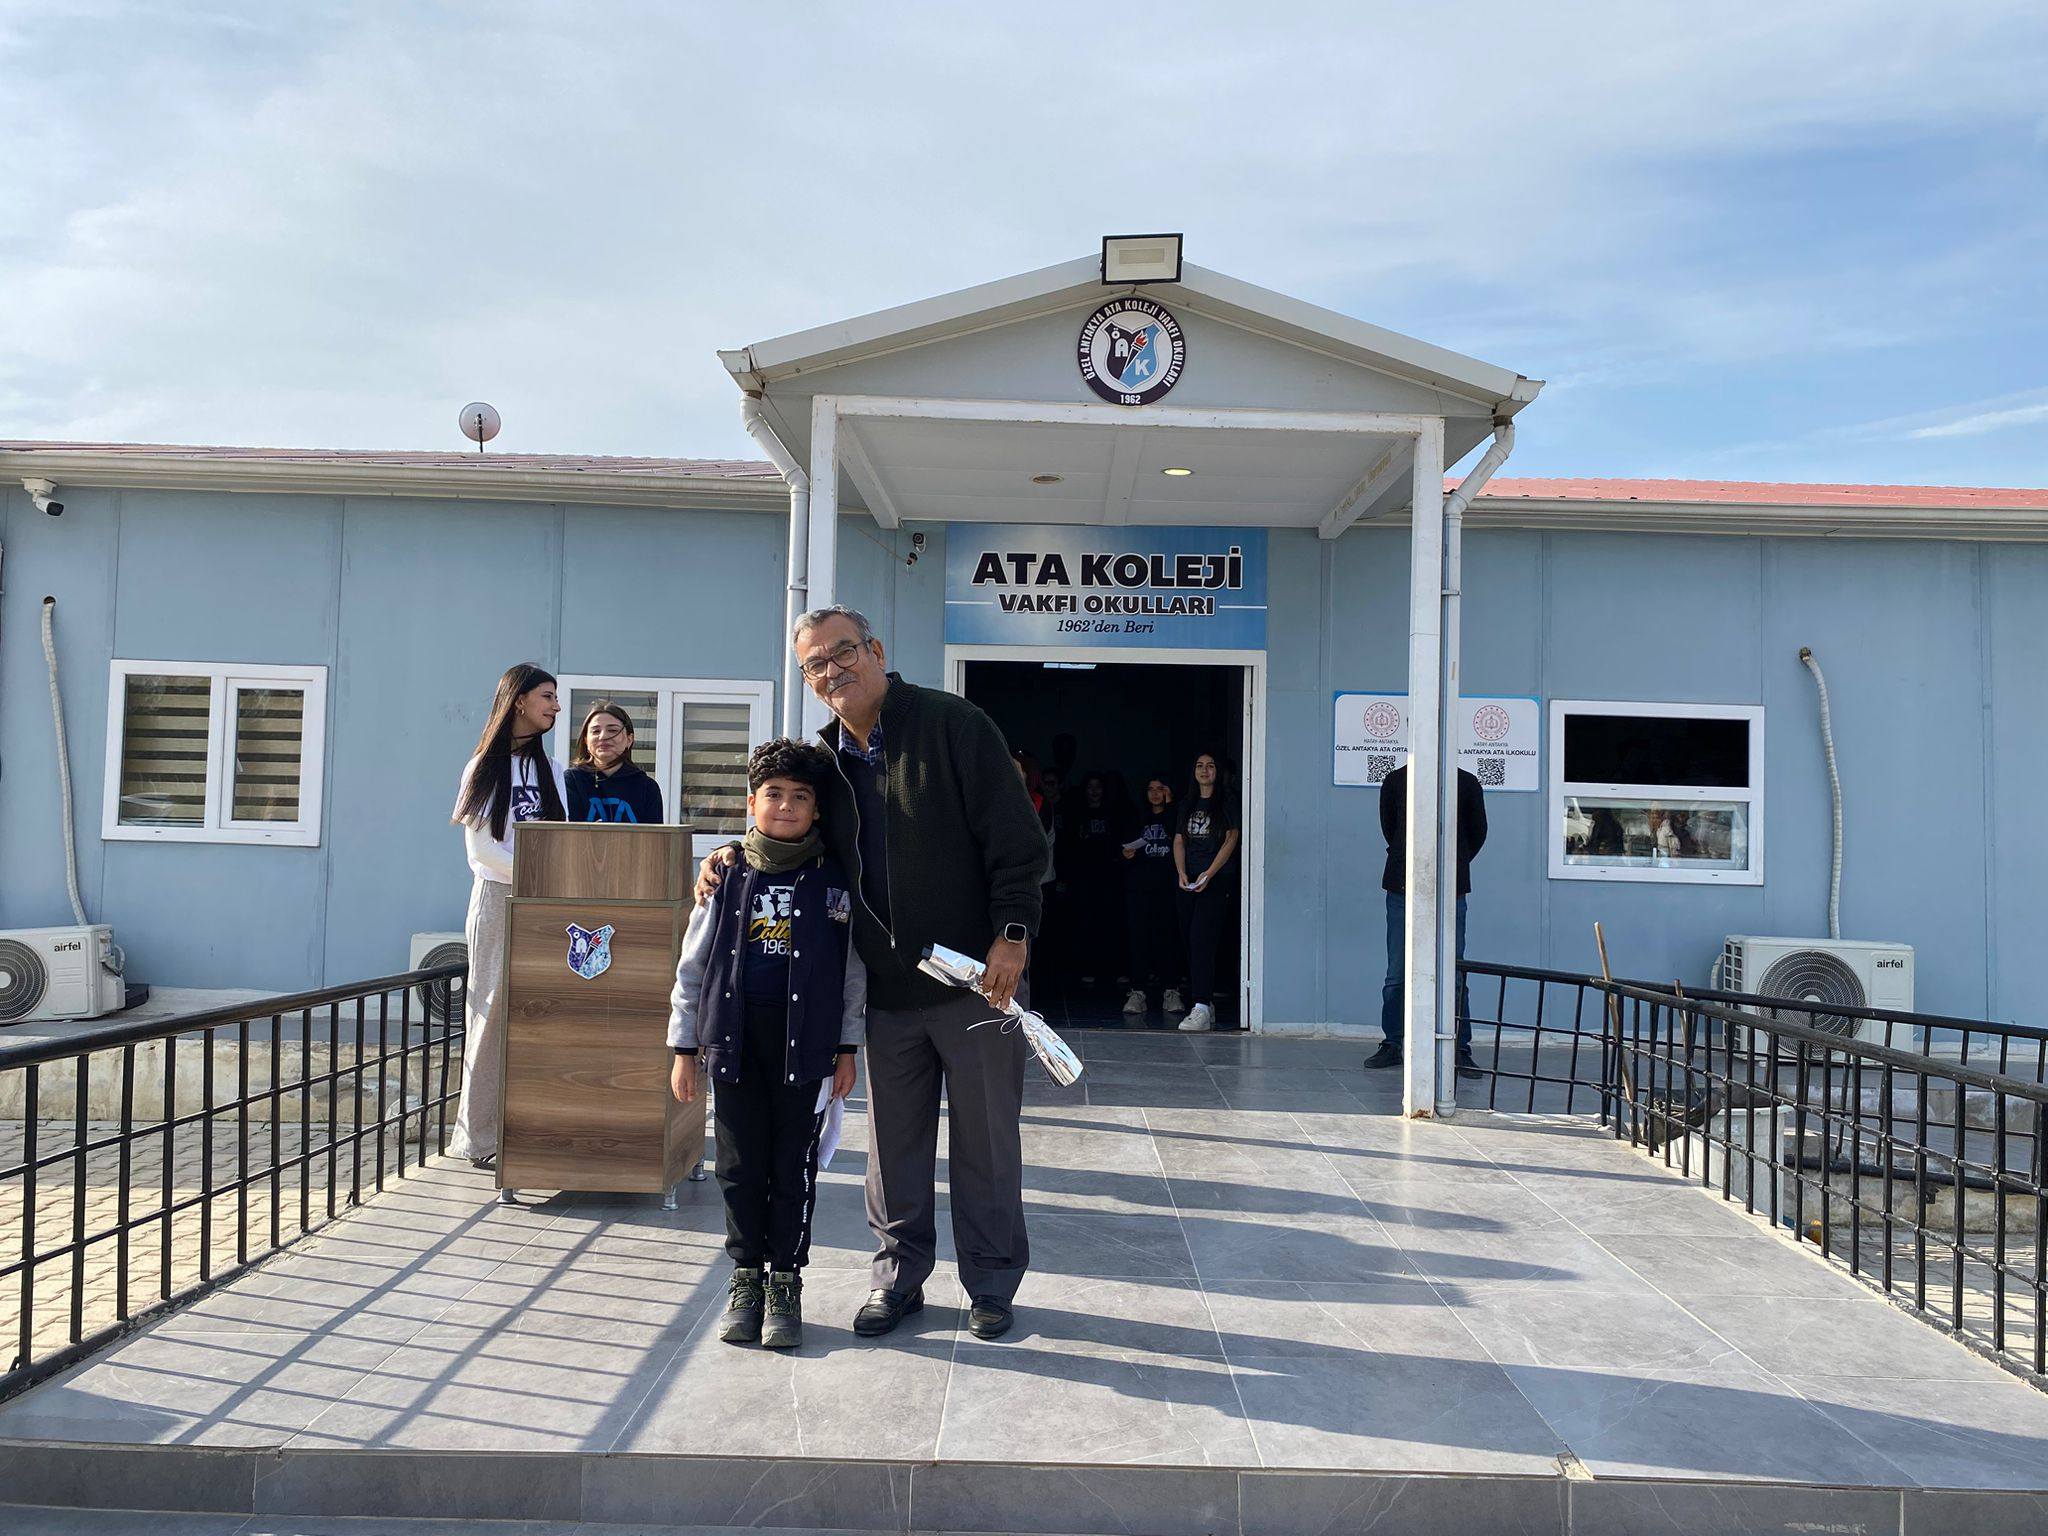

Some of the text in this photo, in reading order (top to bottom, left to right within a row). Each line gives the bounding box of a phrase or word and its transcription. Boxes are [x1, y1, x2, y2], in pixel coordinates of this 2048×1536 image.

[1080, 300, 1184, 388] ÖZEL ANTAKYA ATA KOLEJİ VAKFI OKULLARI
[1120, 394, 1141, 404] 1962
[971, 546, 1243, 590] ATA KOLEJİ
[998, 593, 1215, 616] VAKFI OKULLARI
[1056, 619, 1154, 634] 1962'den Beri
[1464, 748, 1491, 756] ANTAKYA
[1505, 749, 1537, 757] İLKOKULU
[748, 916, 791, 942] Colle
[53, 941, 81, 953] airfel
[1876, 959, 1904, 969] airfel
